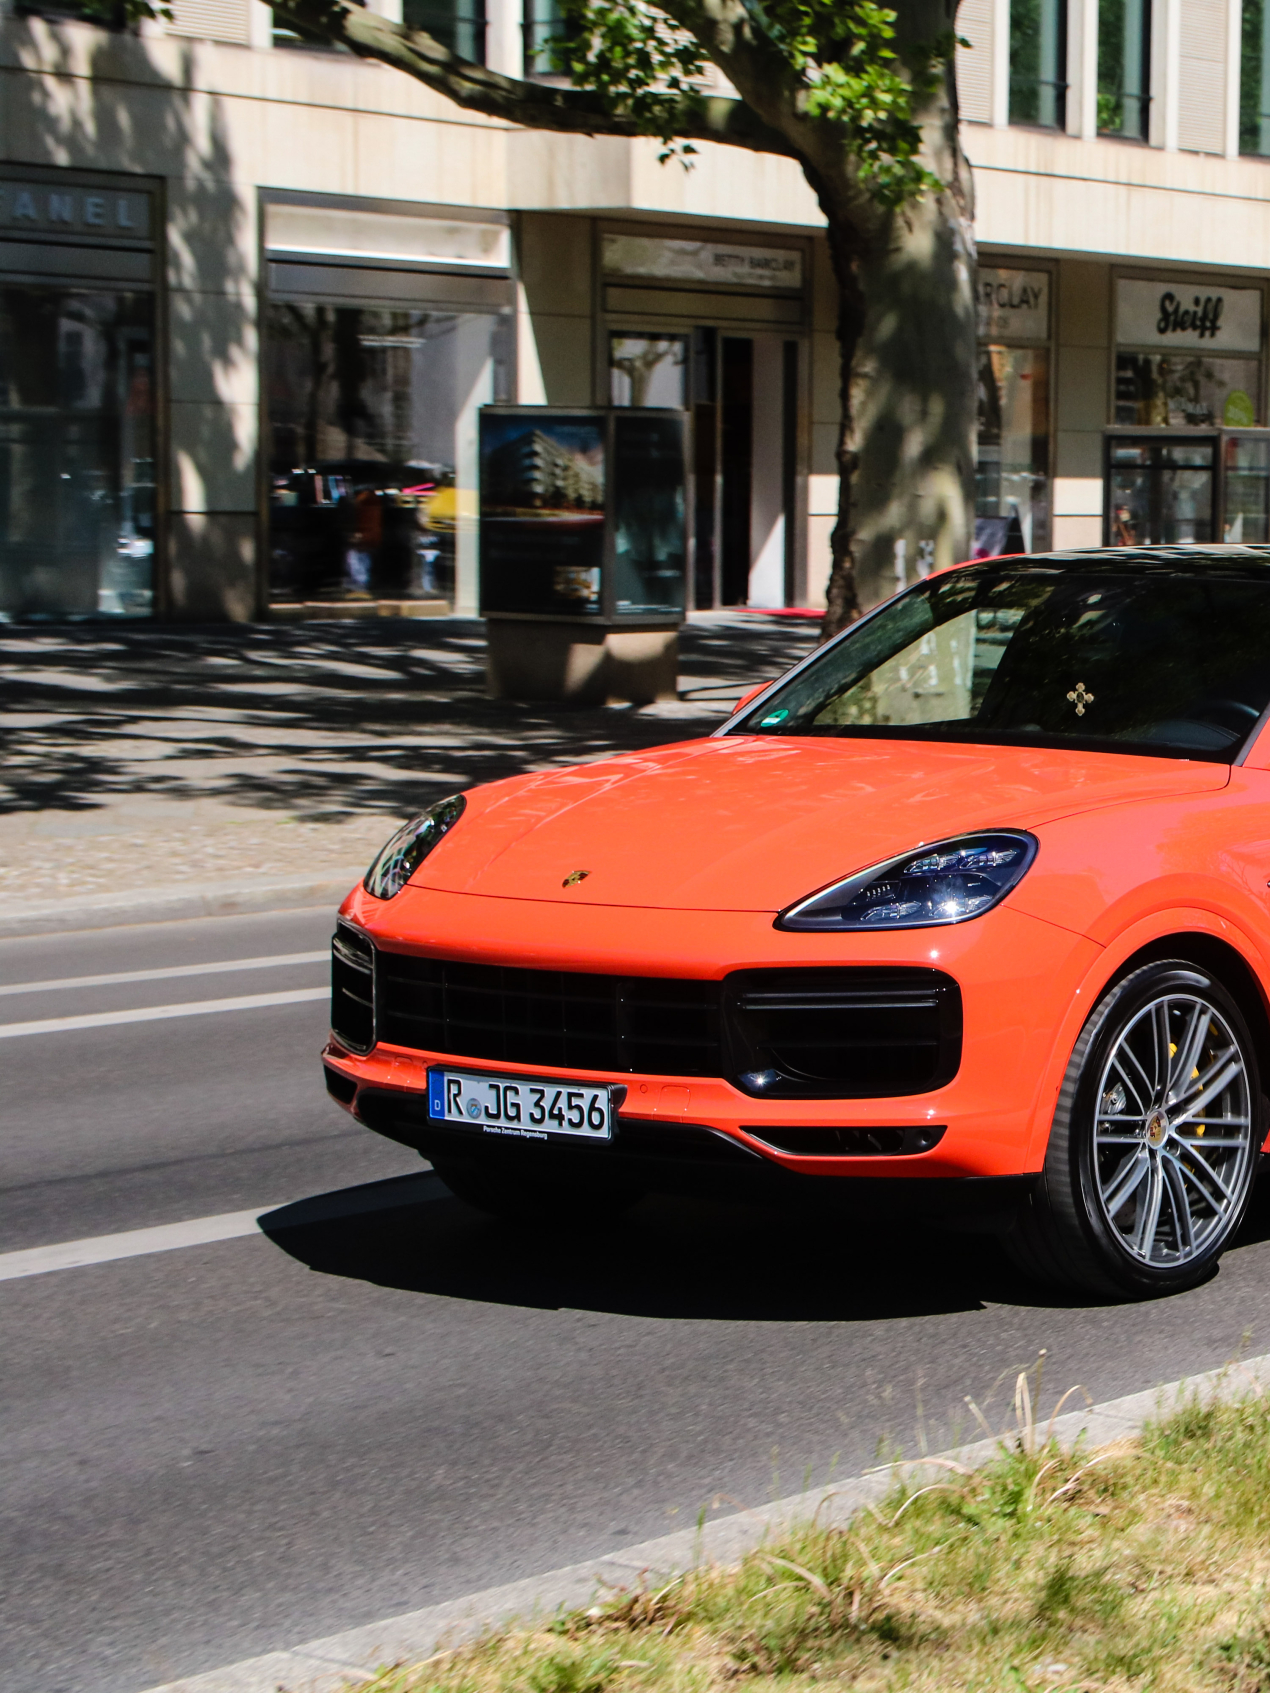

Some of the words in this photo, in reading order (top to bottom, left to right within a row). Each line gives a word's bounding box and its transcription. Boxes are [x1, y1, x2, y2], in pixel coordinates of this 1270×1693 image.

[0, 189, 135, 229] ANEL
[1157, 291, 1224, 339] Steiff
[434, 1099, 441, 1111] D
[446, 1078, 464, 1116] R
[484, 1083, 522, 1123] JG
[529, 1087, 606, 1130] 3456
[483, 1124, 501, 1134] Porsche
[501, 1127, 521, 1136] Zentrum
[521, 1129, 548, 1140] Regensburg
